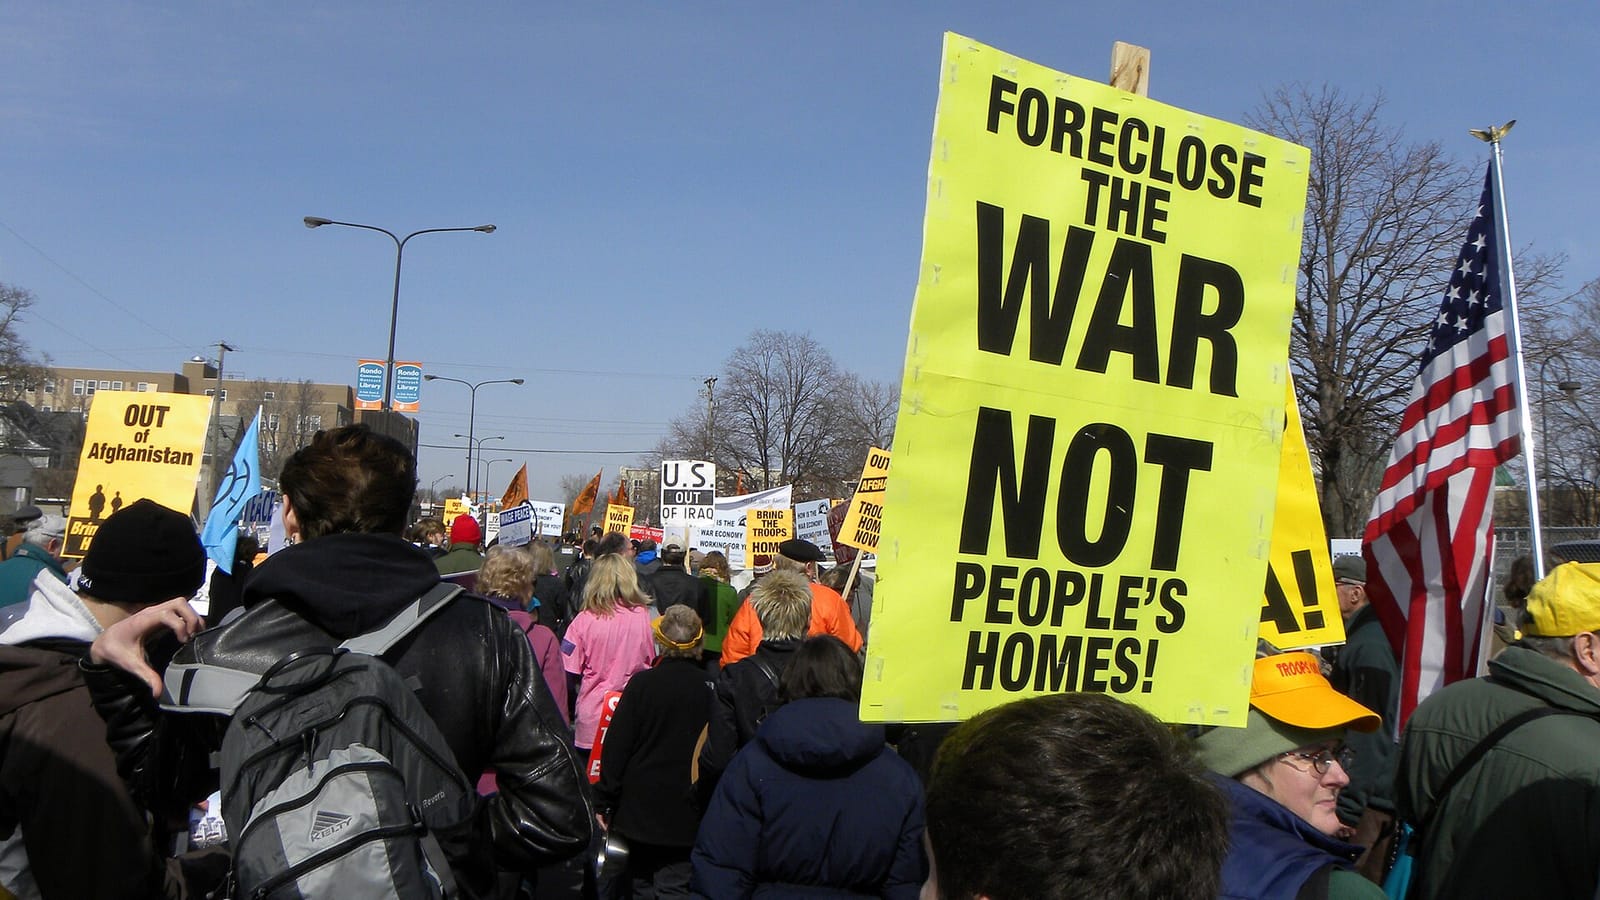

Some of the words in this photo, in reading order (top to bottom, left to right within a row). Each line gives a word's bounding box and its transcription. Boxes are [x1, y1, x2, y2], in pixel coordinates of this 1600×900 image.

[986, 74, 1266, 208] FORECLOSE
[1080, 168, 1171, 244] THE
[976, 200, 1245, 398] WAR
[124, 404, 170, 428] OUT
[134, 429, 150, 443] of
[87, 442, 194, 466] Afghanistan
[663, 463, 714, 487] U.S.
[958, 406, 1214, 572] NOT
[675, 491, 701, 504] OUT
[515, 507, 530, 521] PEACE
[609, 512, 629, 523] WAR
[662, 507, 677, 519] OF
[684, 507, 714, 520] IRAQ
[756, 510, 784, 520] BRING
[859, 501, 883, 519] TROO
[70, 521, 99, 536] Brin
[609, 523, 627, 532] NOT
[724, 519, 735, 528] THE
[761, 520, 778, 528] THE
[858, 516, 882, 534] HOM
[700, 529, 714, 537] WAR
[715, 530, 743, 538] ECONOMY
[753, 528, 787, 537] TROOPS
[699, 540, 726, 549] WORKING
[752, 541, 779, 553] HOM
[950, 562, 1188, 634] PEOPLE'S
[961, 631, 1159, 693] HOMES!
[1276, 661, 1311, 677] TROOPS
[422, 791, 445, 808] Reverb
[311, 816, 352, 842] KELTY
